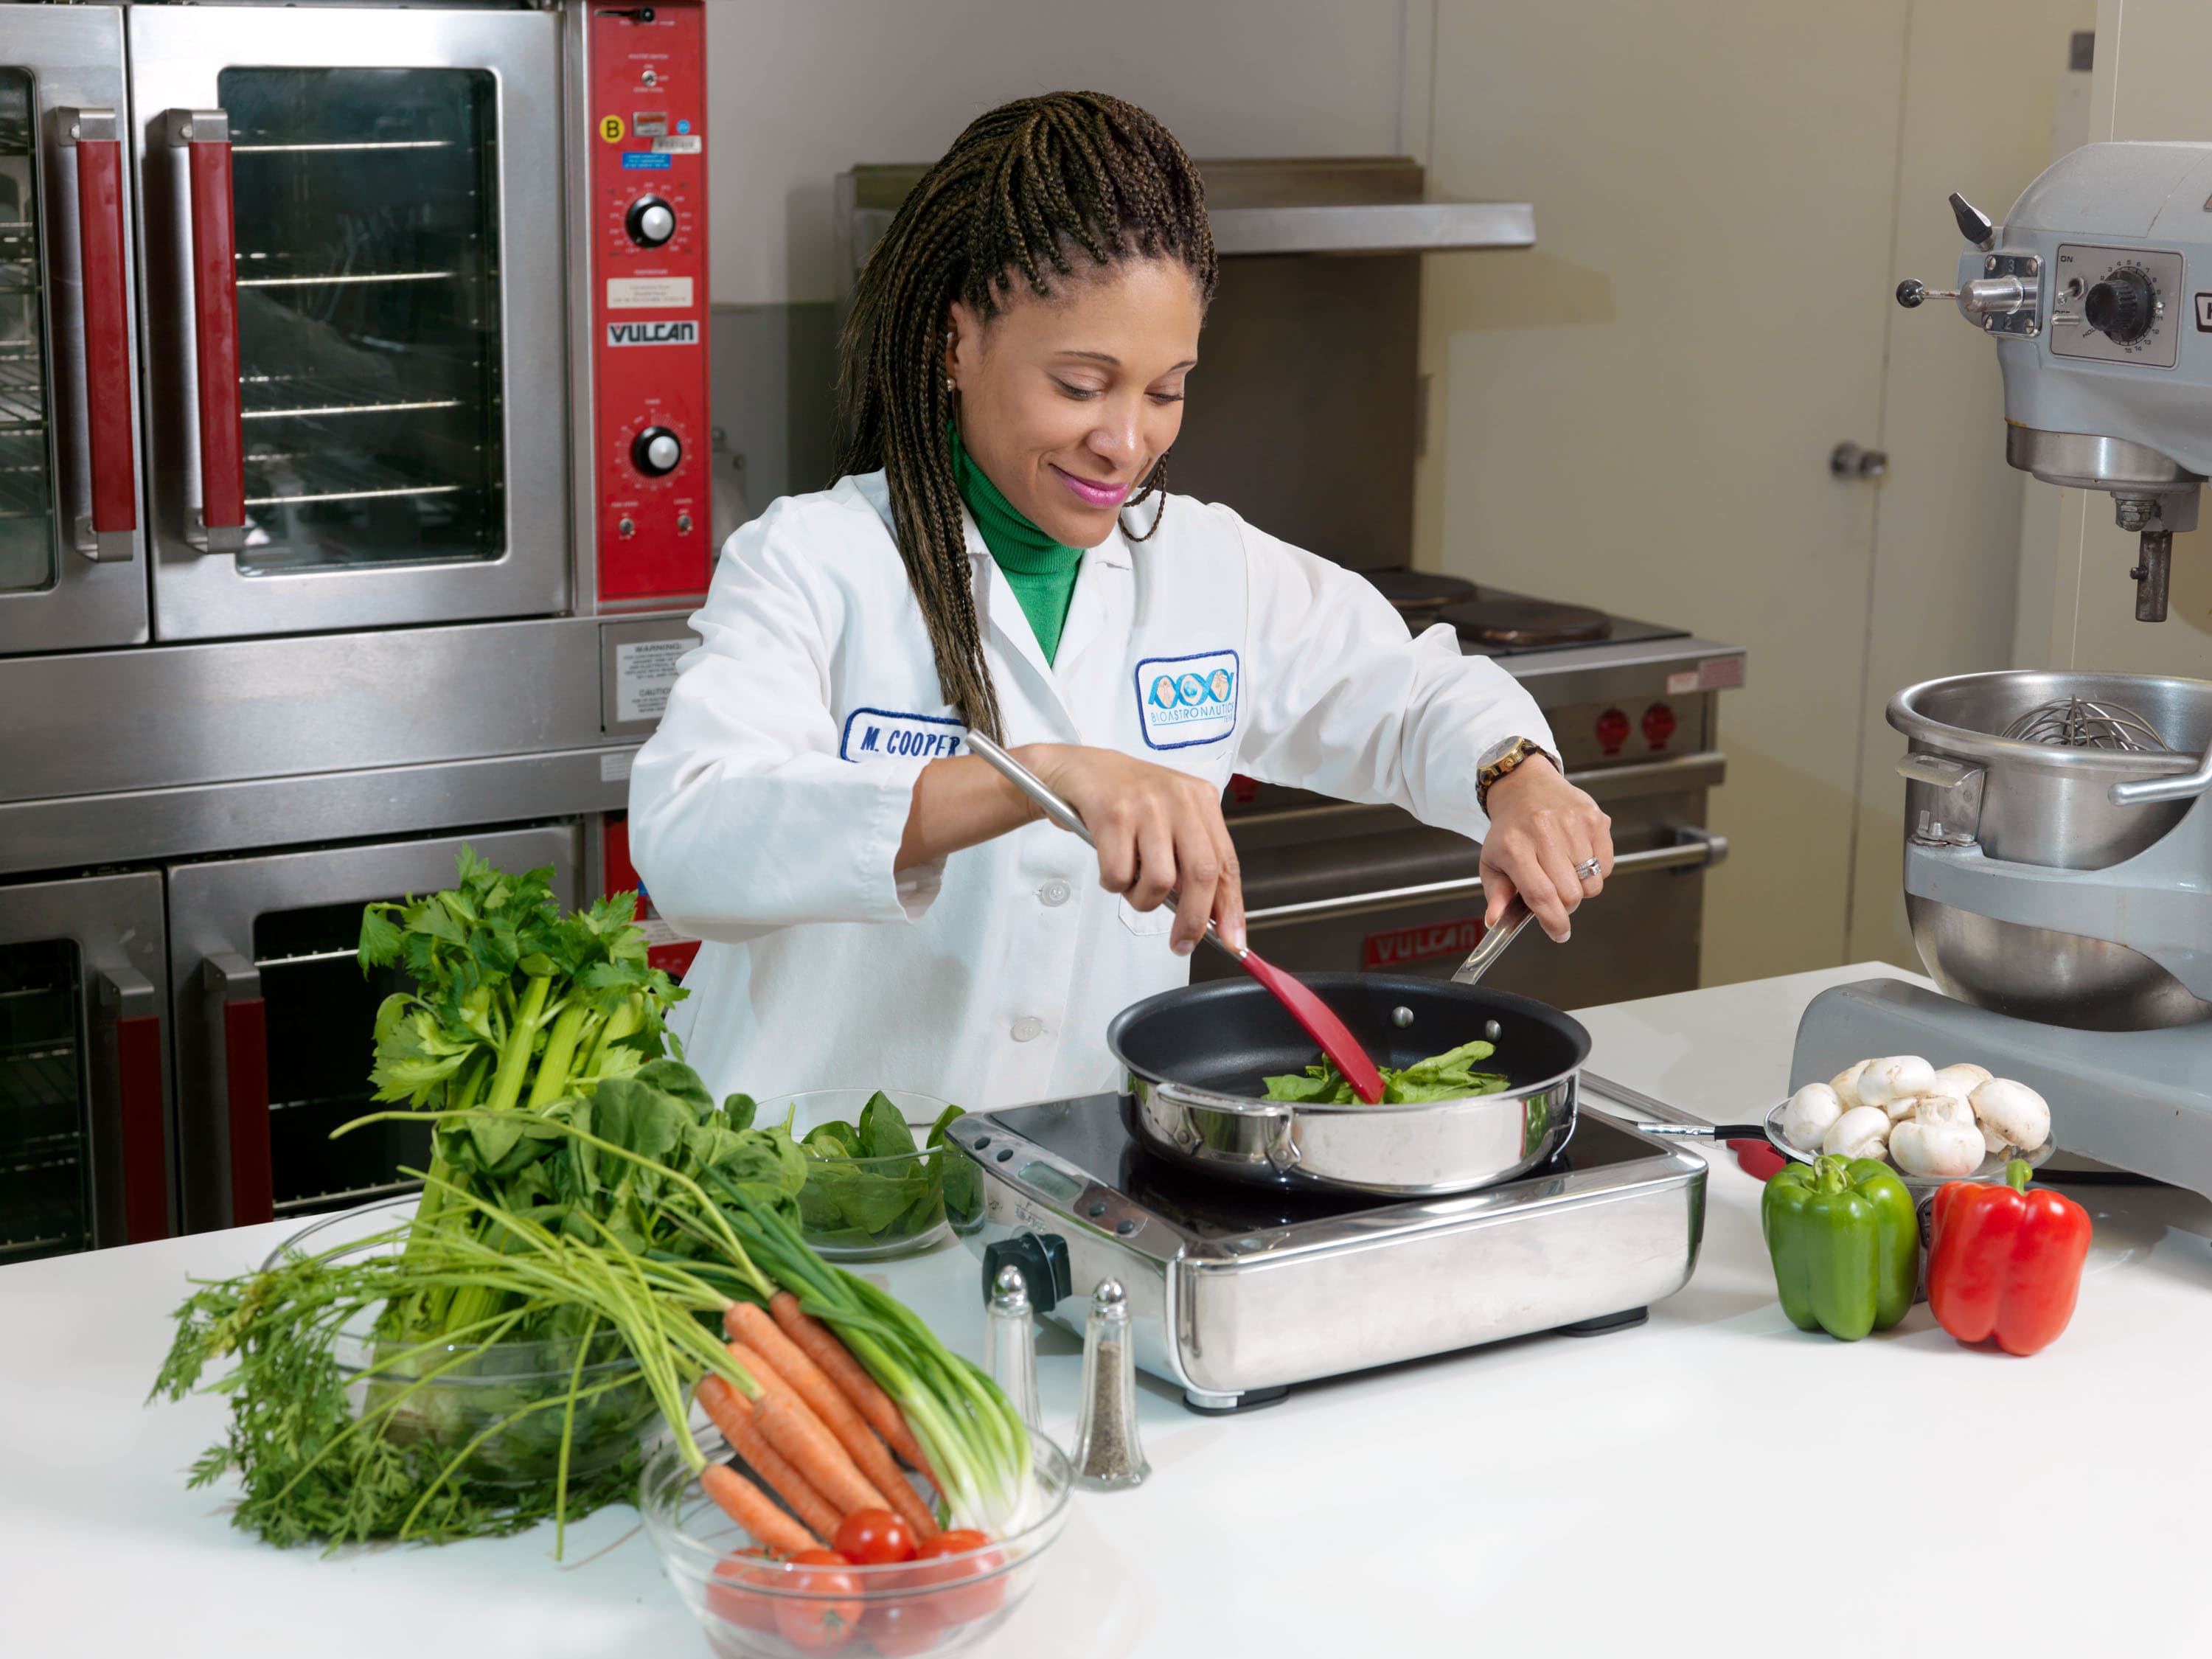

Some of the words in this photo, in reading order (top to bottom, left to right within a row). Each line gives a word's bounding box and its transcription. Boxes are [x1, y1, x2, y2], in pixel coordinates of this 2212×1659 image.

[607, 120, 620, 138] B
[2008, 260, 2015, 272] 3
[610, 322, 694, 343] VULCAN
[2003, 316, 2011, 330] 2
[860, 726, 880, 752] M.
[1375, 924, 1475, 961] VULCAN
